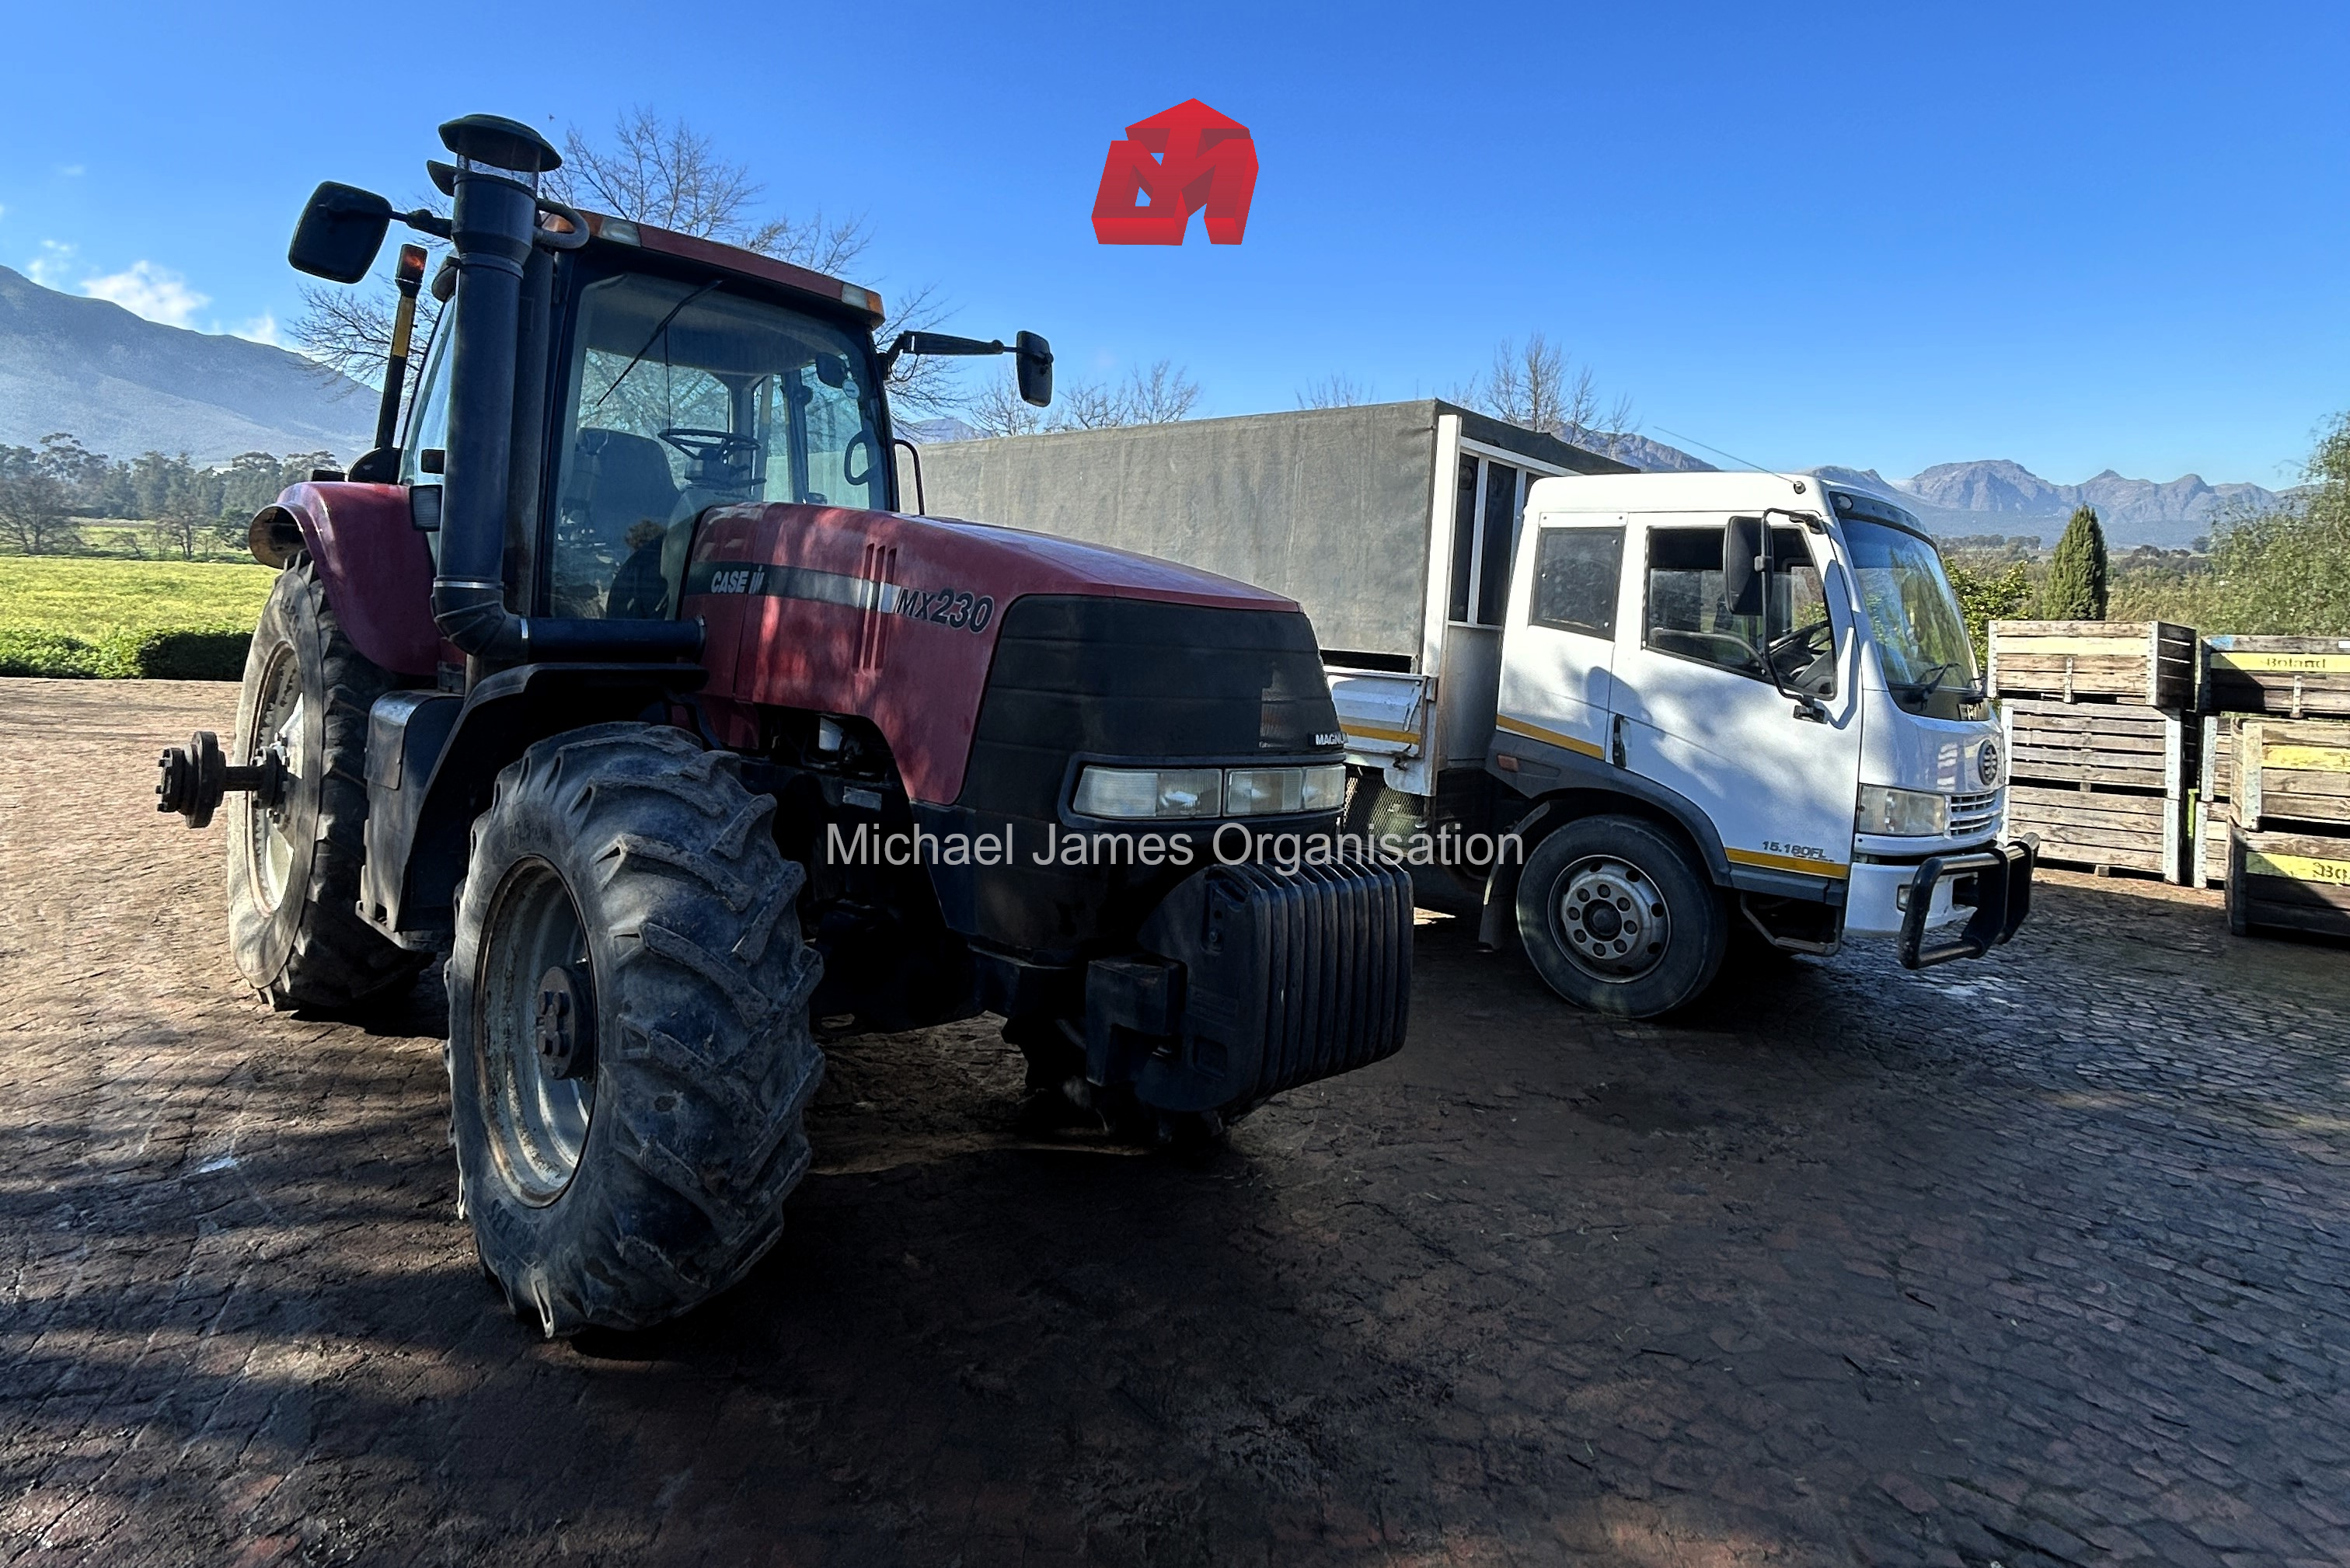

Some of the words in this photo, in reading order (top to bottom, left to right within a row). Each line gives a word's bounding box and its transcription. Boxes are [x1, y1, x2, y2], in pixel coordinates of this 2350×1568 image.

[711, 570, 749, 594] CASE
[896, 587, 994, 633] MX230
[1762, 841, 1826, 858] 15.180FL
